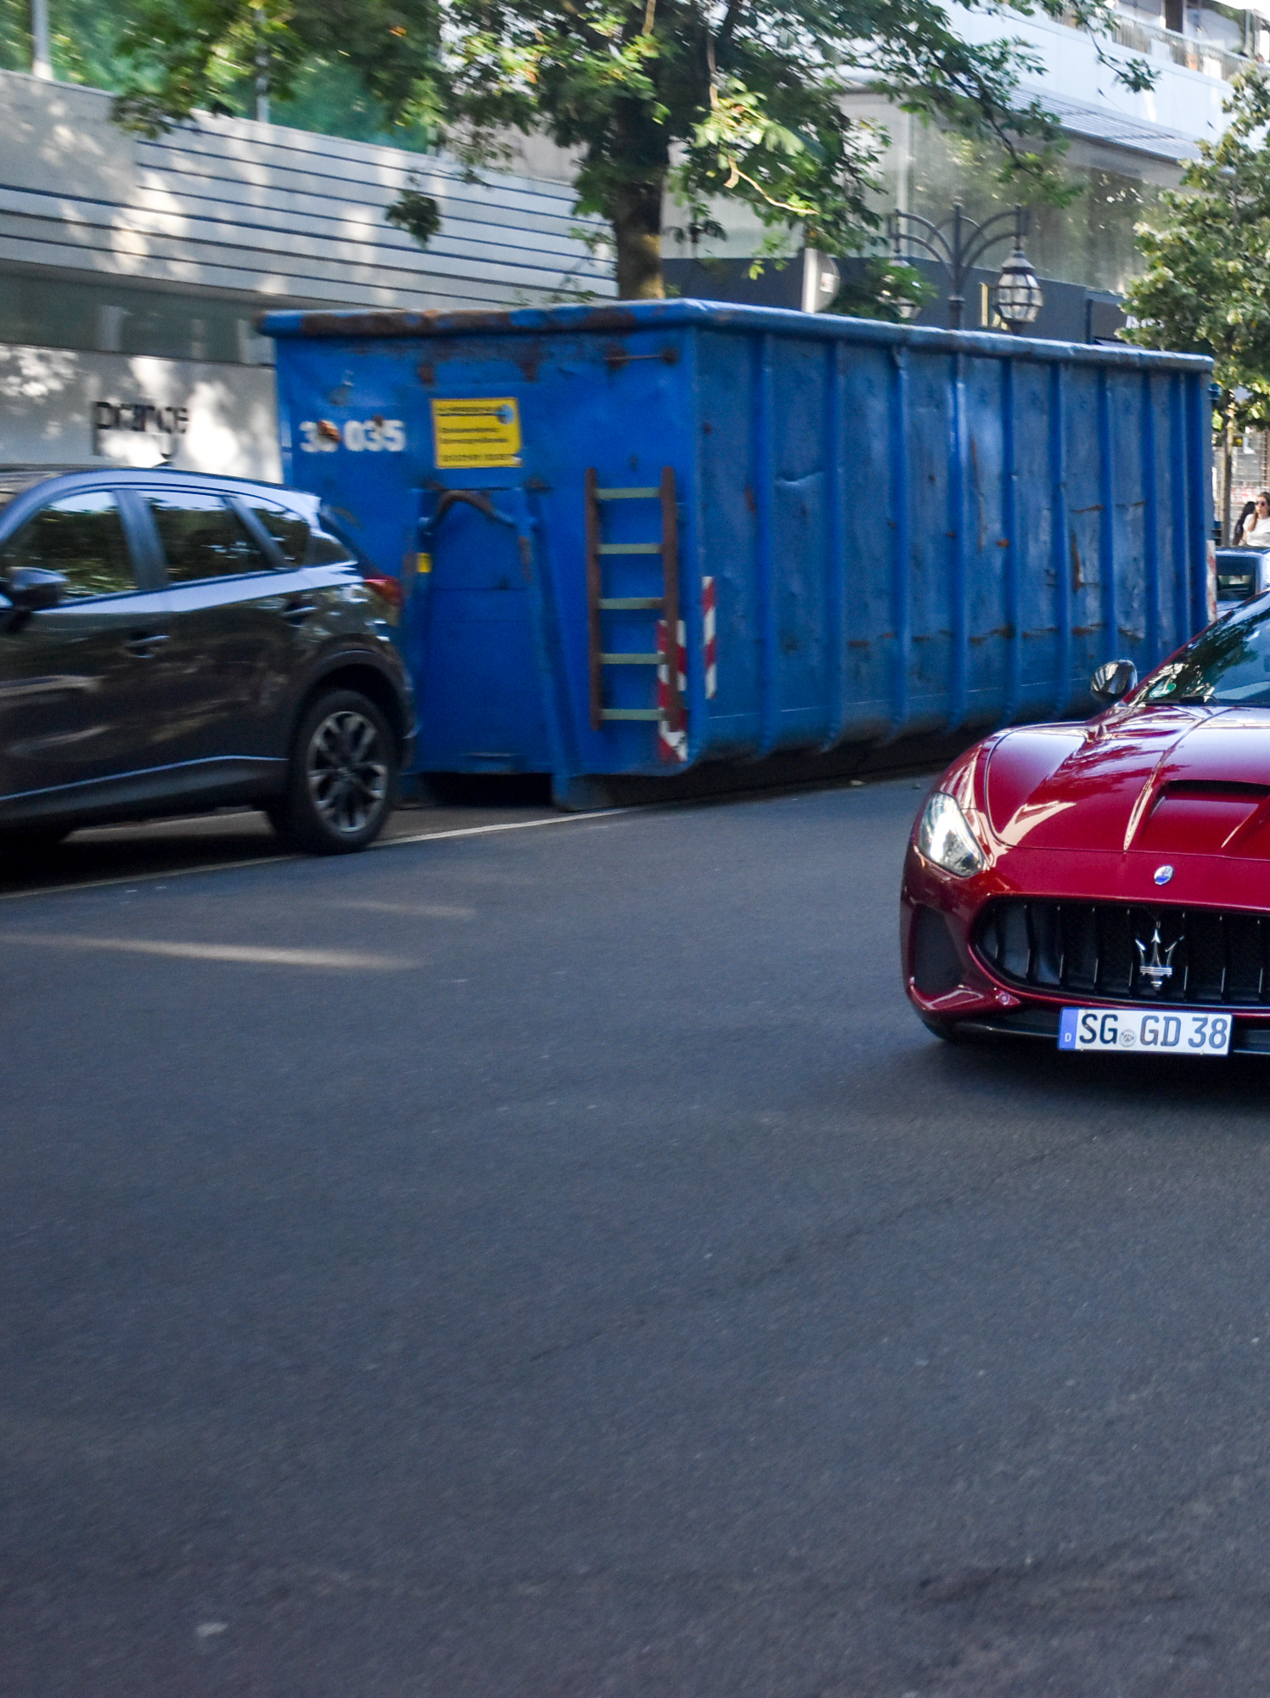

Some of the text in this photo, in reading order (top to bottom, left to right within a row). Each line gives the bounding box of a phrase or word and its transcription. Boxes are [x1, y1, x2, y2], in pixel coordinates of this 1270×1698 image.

[344, 420, 405, 452] 035
[1064, 1032, 1072, 1042] D
[1079, 1013, 1228, 1049] SG GD 38
